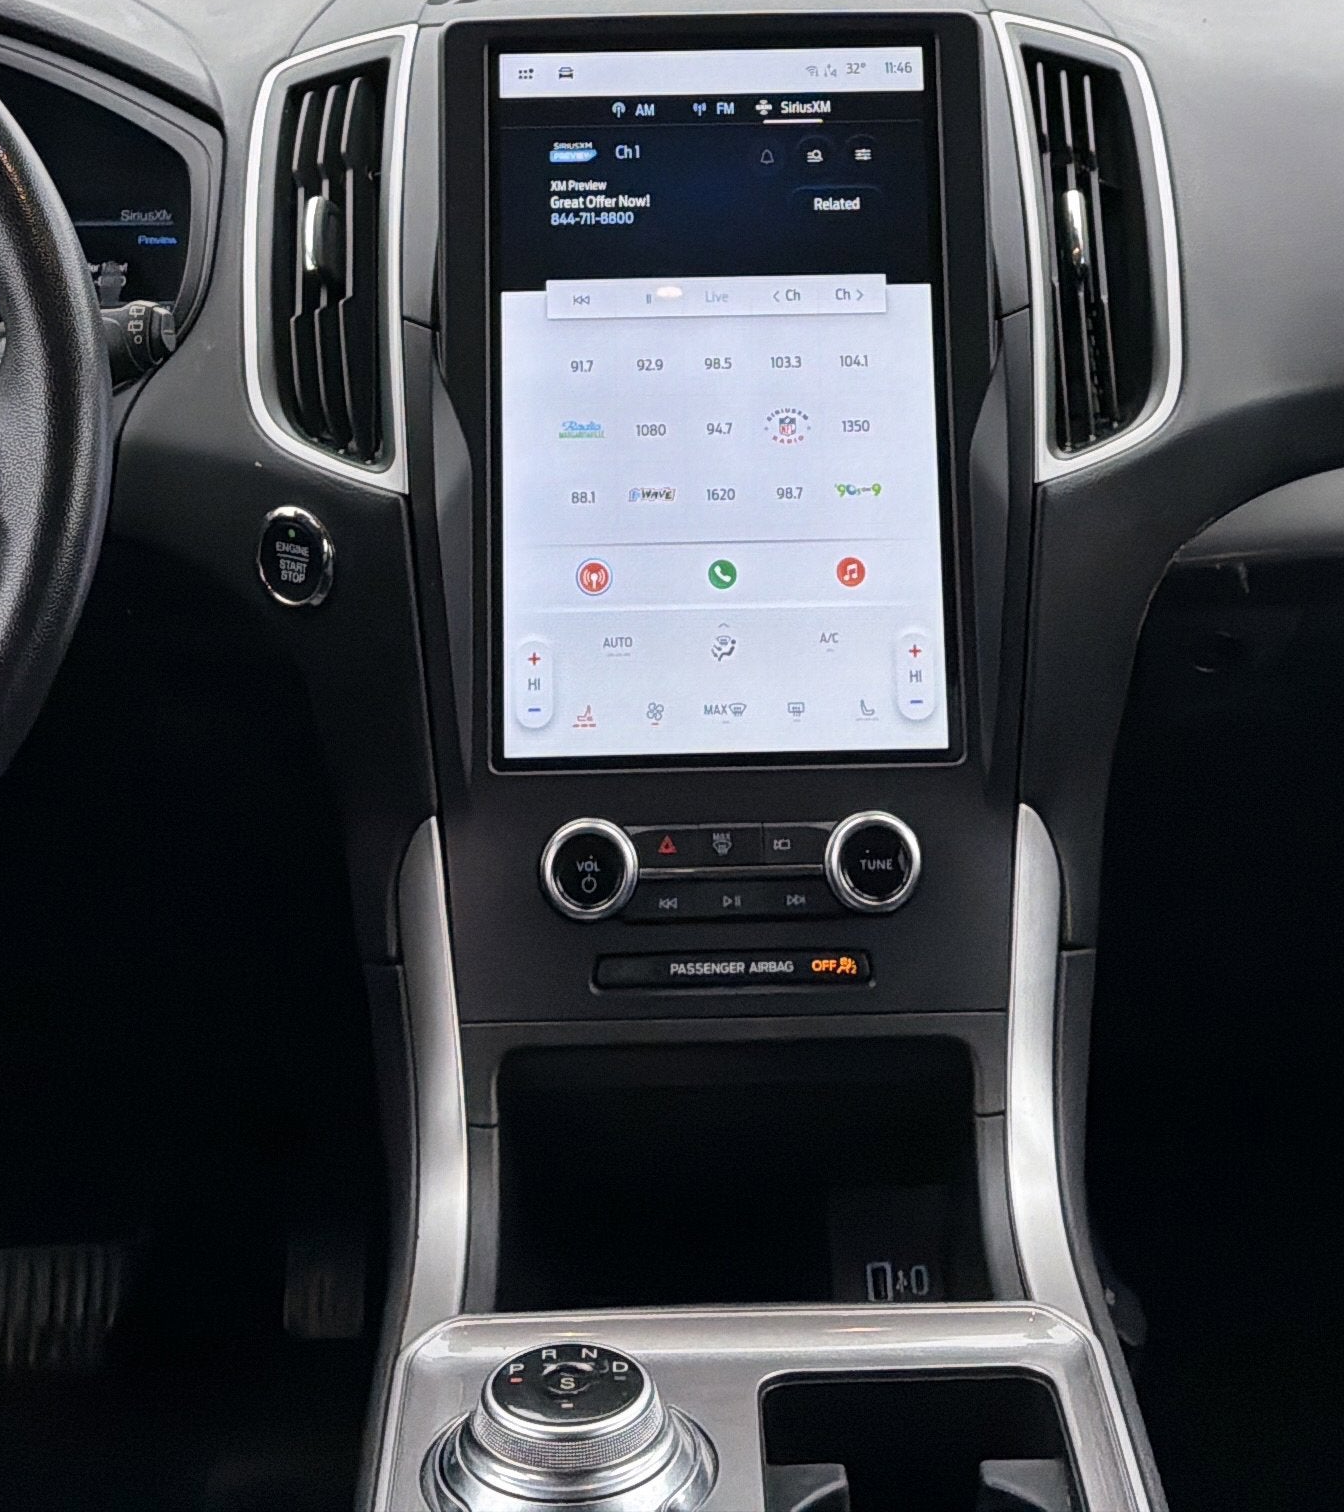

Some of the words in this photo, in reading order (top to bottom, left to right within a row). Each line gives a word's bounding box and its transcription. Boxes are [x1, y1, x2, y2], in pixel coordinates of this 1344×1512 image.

[885, 62, 912, 74] 11:46
[635, 103, 655, 116] AM
[716, 102, 735, 115] FM
[780, 100, 831, 114] SiriusXM
[615, 145, 633, 159] Ch
[635, 145, 641, 159] 1
[550, 180, 566, 191] XM
[568, 179, 607, 191] Preview
[550, 195, 584, 208] Great
[586, 195, 616, 208] Offer
[618, 194, 651, 207] Now!
[814, 197, 860, 210] Related
[551, 211, 634, 225] 844-711-8800
[705, 291, 729, 303] Live
[785, 289, 801, 302] Ch
[835, 288, 851, 301] Ch
[570, 360, 594, 372] 91.7
[636, 359, 664, 371] 92.9
[704, 357, 732, 370] 98.5
[770, 356, 802, 368] 103.3
[839, 354, 869, 367] 104.1
[636, 424, 667, 436] 1080
[706, 422, 733, 435] 94.7
[841, 420, 870, 432] 1350
[571, 492, 596, 504] 88.1
[706, 488, 736, 501] 1620
[776, 487, 803, 499] 98.7
[275, 541, 310, 557] ENGINE
[279, 559, 307, 574] START
[281, 570, 306, 584] STOP
[603, 637, 633, 648] AUTO
[820, 632, 839, 644] A/C
[909, 670, 922, 683] HI
[528, 678, 541, 691] HI
[704, 703, 728, 716] MAX
[577, 861, 600, 872] VOL
[860, 859, 892, 871] TUNE
[670, 962, 745, 975] PASSENGER
[749, 960, 794, 974] AIRBAG
[811, 959, 837, 972] OFF
[542, 1349, 557, 1360] R
[581, 1348, 597, 1359] N
[509, 1363, 524, 1375] P
[612, 1361, 628, 1373] D
[560, 1377, 575, 1389] S
